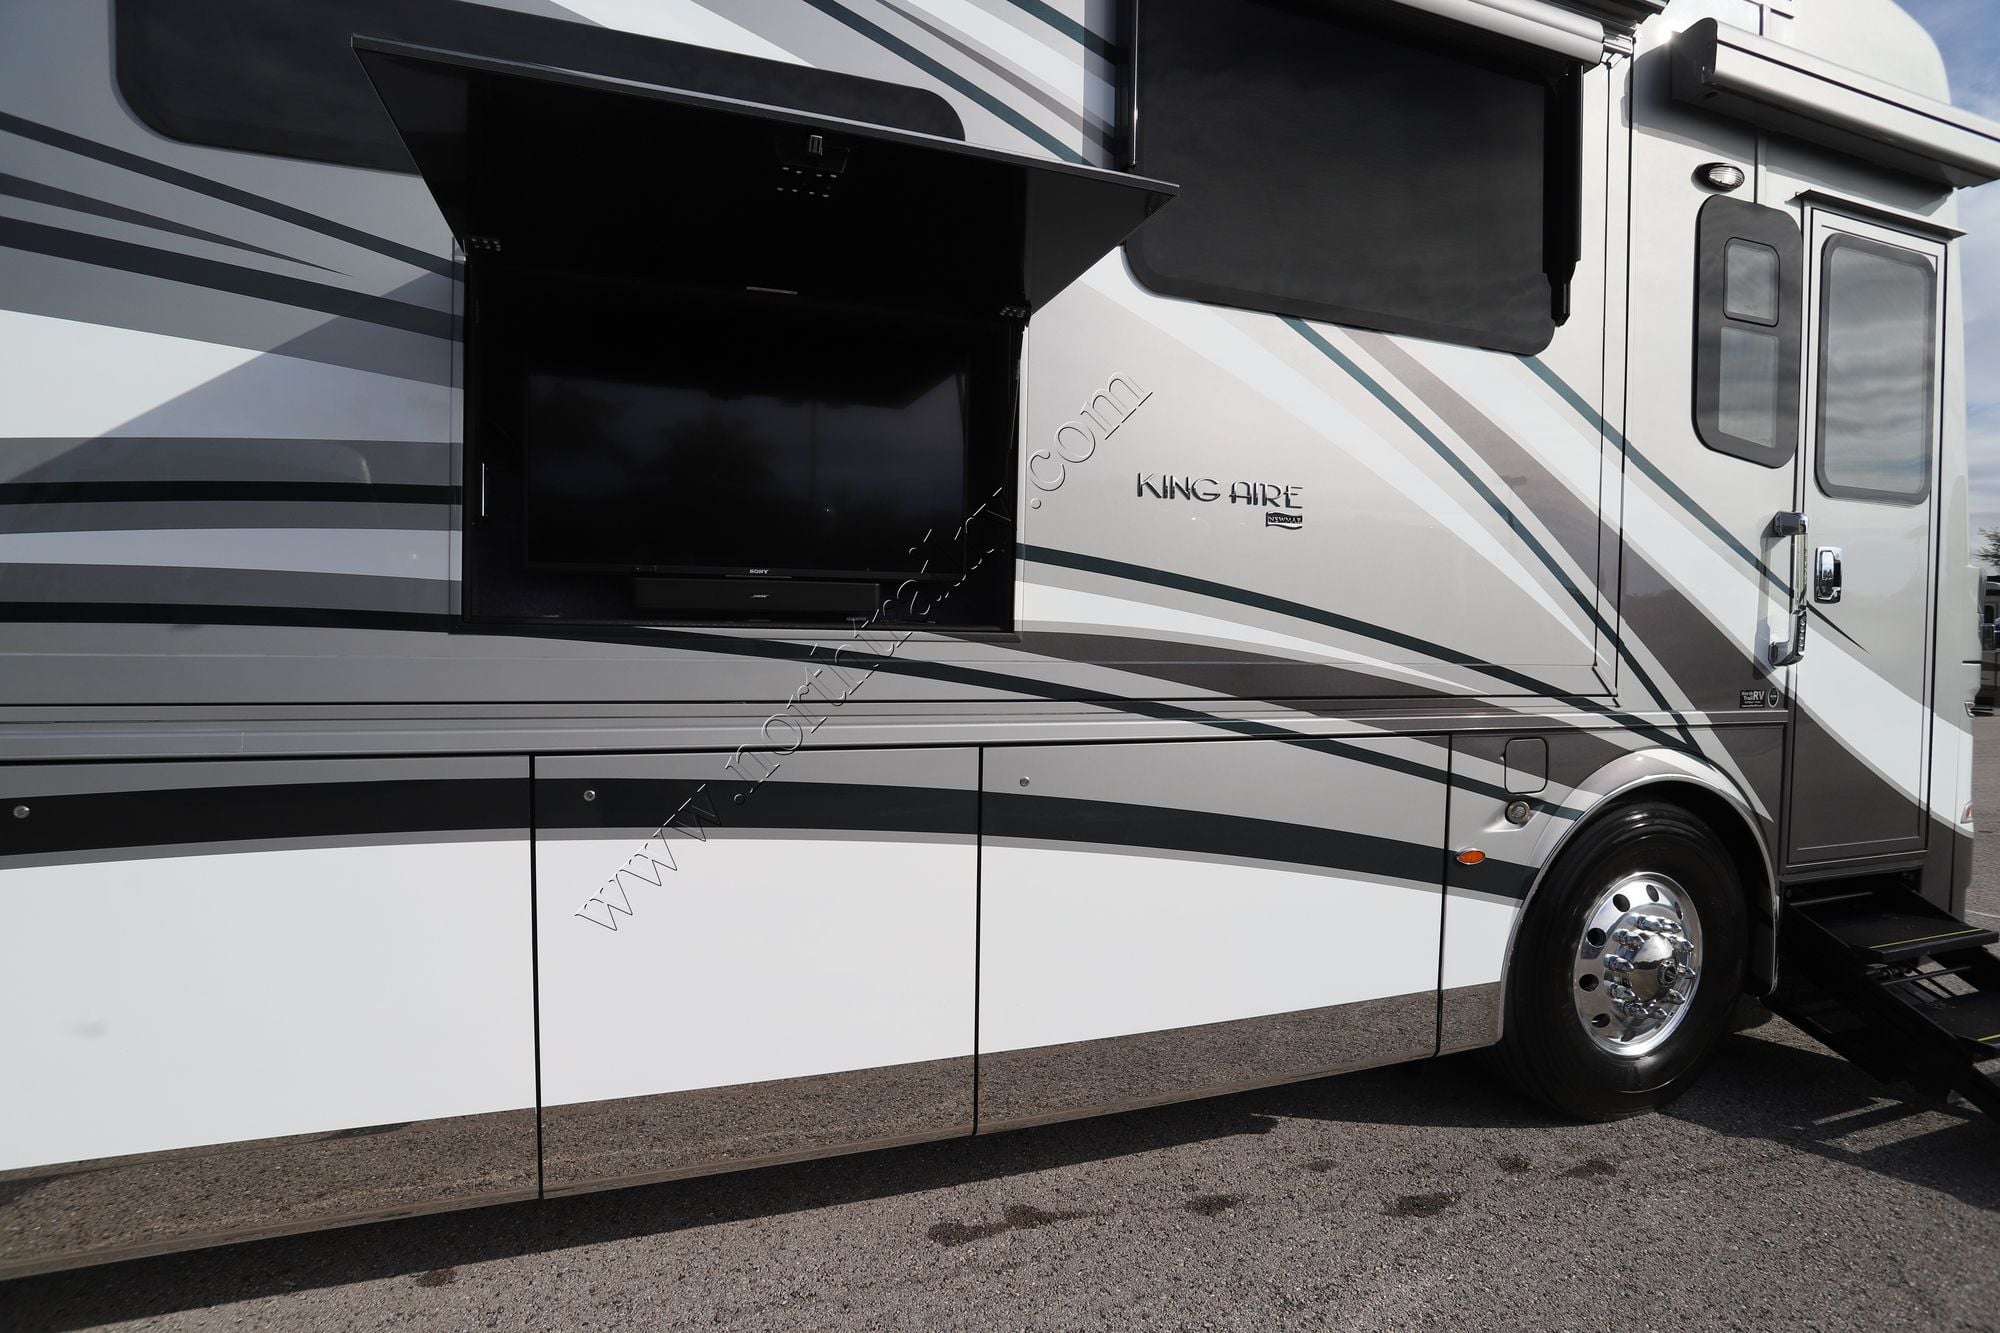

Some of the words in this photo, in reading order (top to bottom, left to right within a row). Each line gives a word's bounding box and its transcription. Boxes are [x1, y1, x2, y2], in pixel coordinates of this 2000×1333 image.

[1137, 472, 1221, 502] KING
[1229, 480, 1304, 509] AIRE
[1753, 690, 1765, 701] RV
